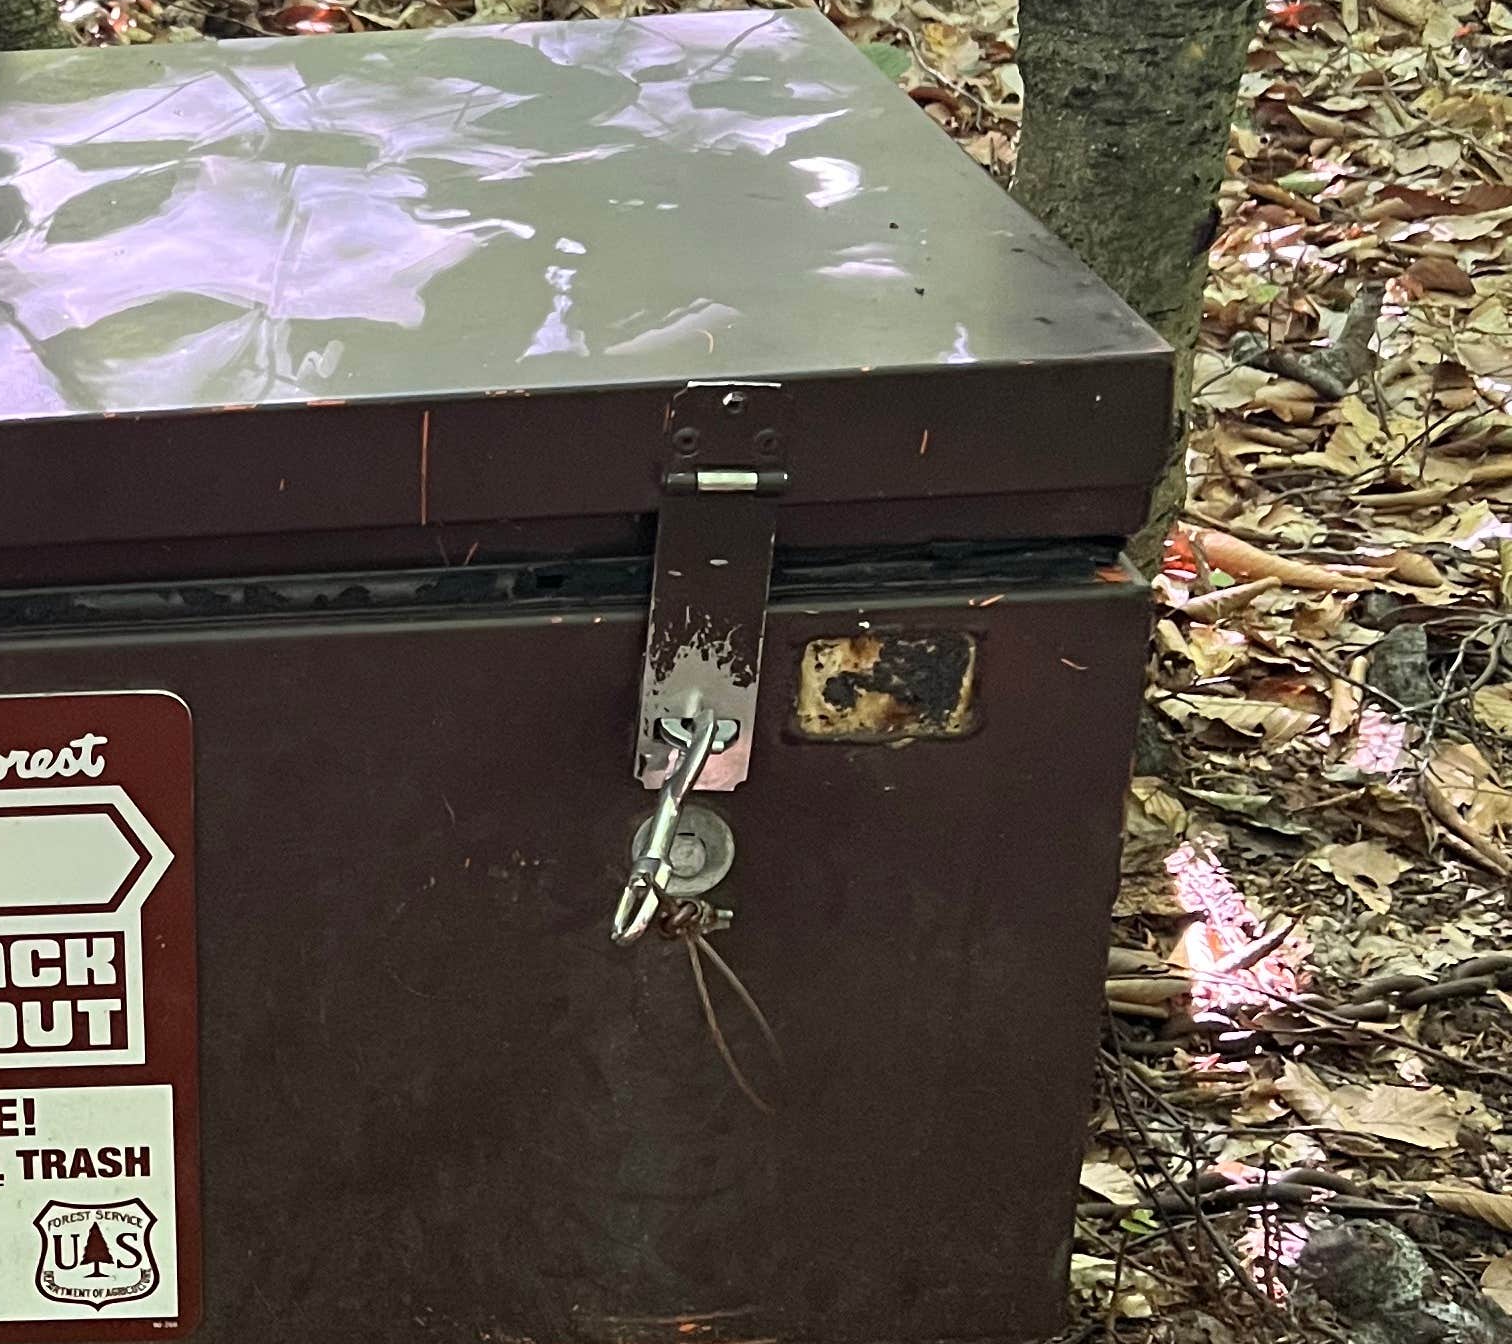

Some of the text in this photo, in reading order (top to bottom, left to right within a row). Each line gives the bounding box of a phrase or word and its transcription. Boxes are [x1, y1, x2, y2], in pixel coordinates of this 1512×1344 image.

[16, 1146, 151, 1181] TRASH
[47, 1210, 143, 1231] FOREST SERVICE
[92, 1288, 105, 1298] OF
